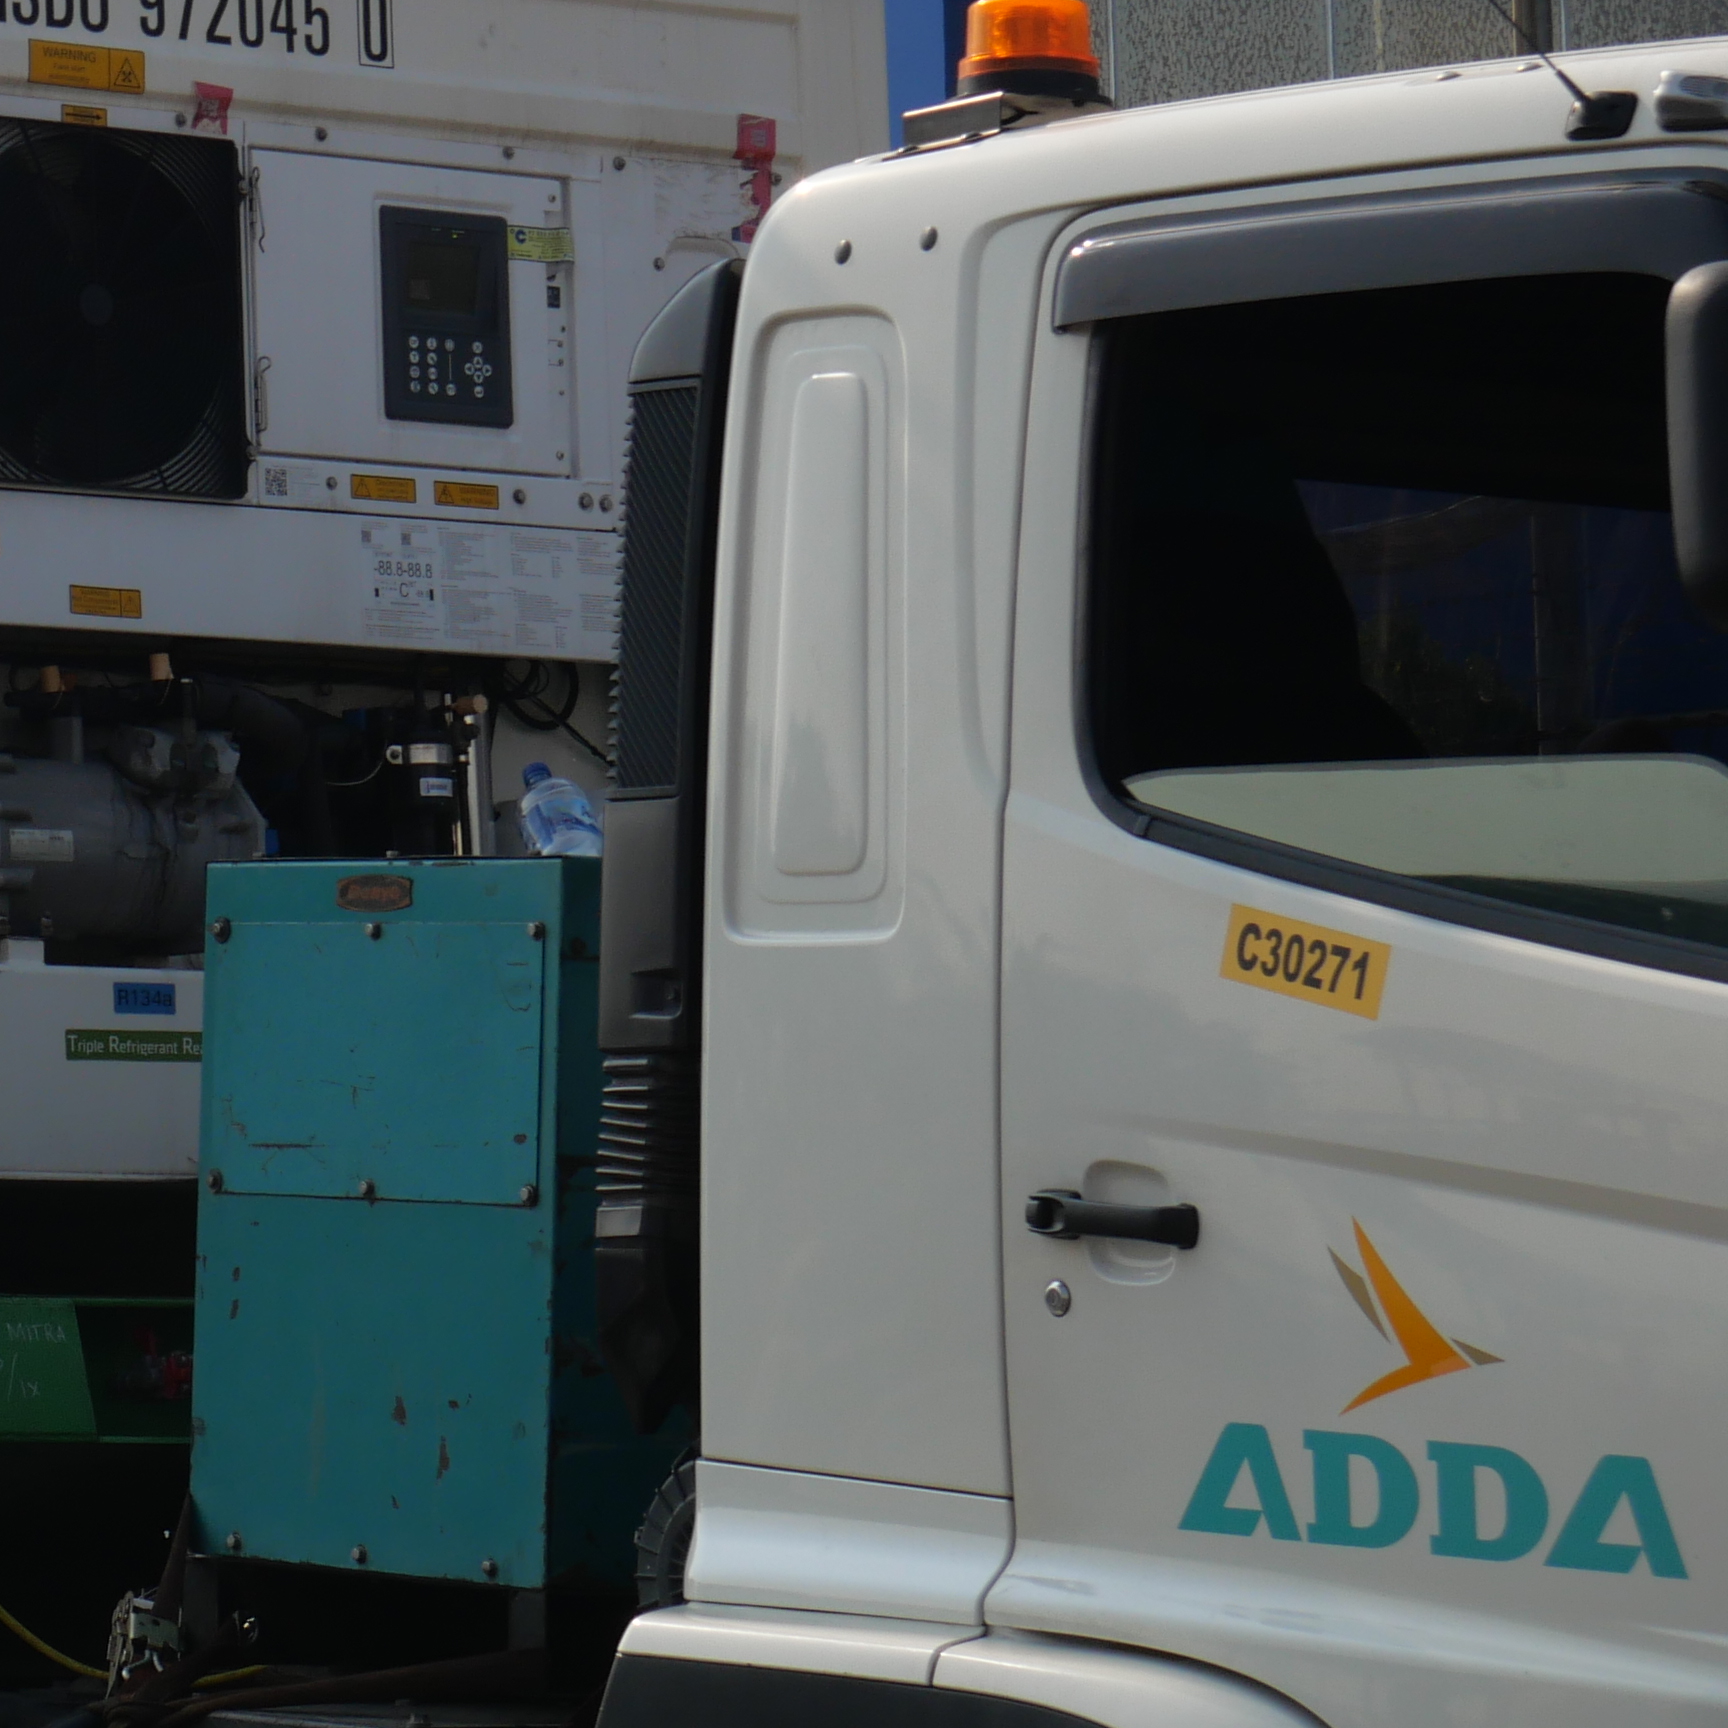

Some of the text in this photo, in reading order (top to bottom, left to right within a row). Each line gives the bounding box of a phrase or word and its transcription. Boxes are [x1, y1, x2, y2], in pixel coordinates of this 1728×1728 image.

[42, 47, 98, 64] WARNING
[1236, 922, 1372, 1002] C30271
[117, 989, 173, 1007] R134a
[67, 1035, 104, 1055] Triple
[108, 1035, 179, 1056] Refrigerant
[5, 1322, 67, 1343] MITRA
[1177, 1421, 1690, 1580] ADDA
